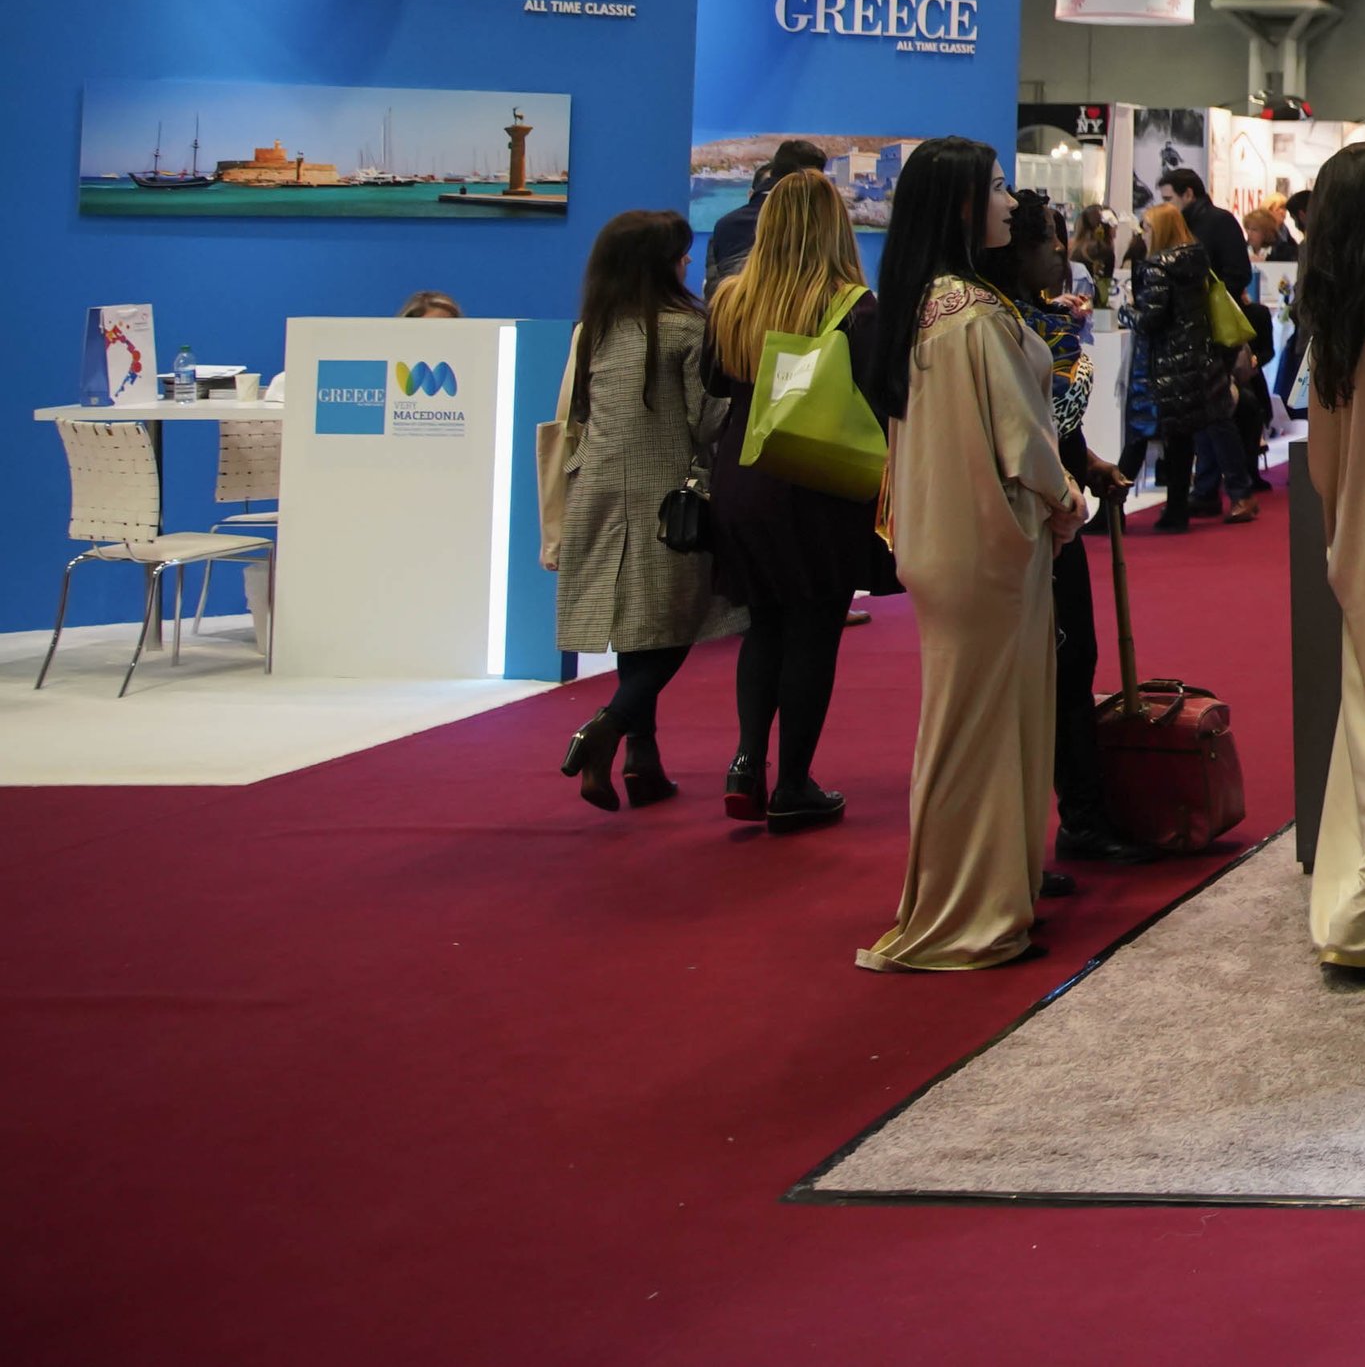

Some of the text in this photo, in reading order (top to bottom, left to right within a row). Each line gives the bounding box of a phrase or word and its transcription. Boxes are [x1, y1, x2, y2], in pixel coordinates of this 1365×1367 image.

[524, 0, 636, 17] ALL TIME CLASSIC
[896, 40, 976, 55] ALL TIME CLASSIC
[1076, 119, 1103, 133] NY
[318, 388, 385, 403] GREECE
[394, 401, 418, 410] VERY
[393, 410, 465, 421] MACEDONIA
